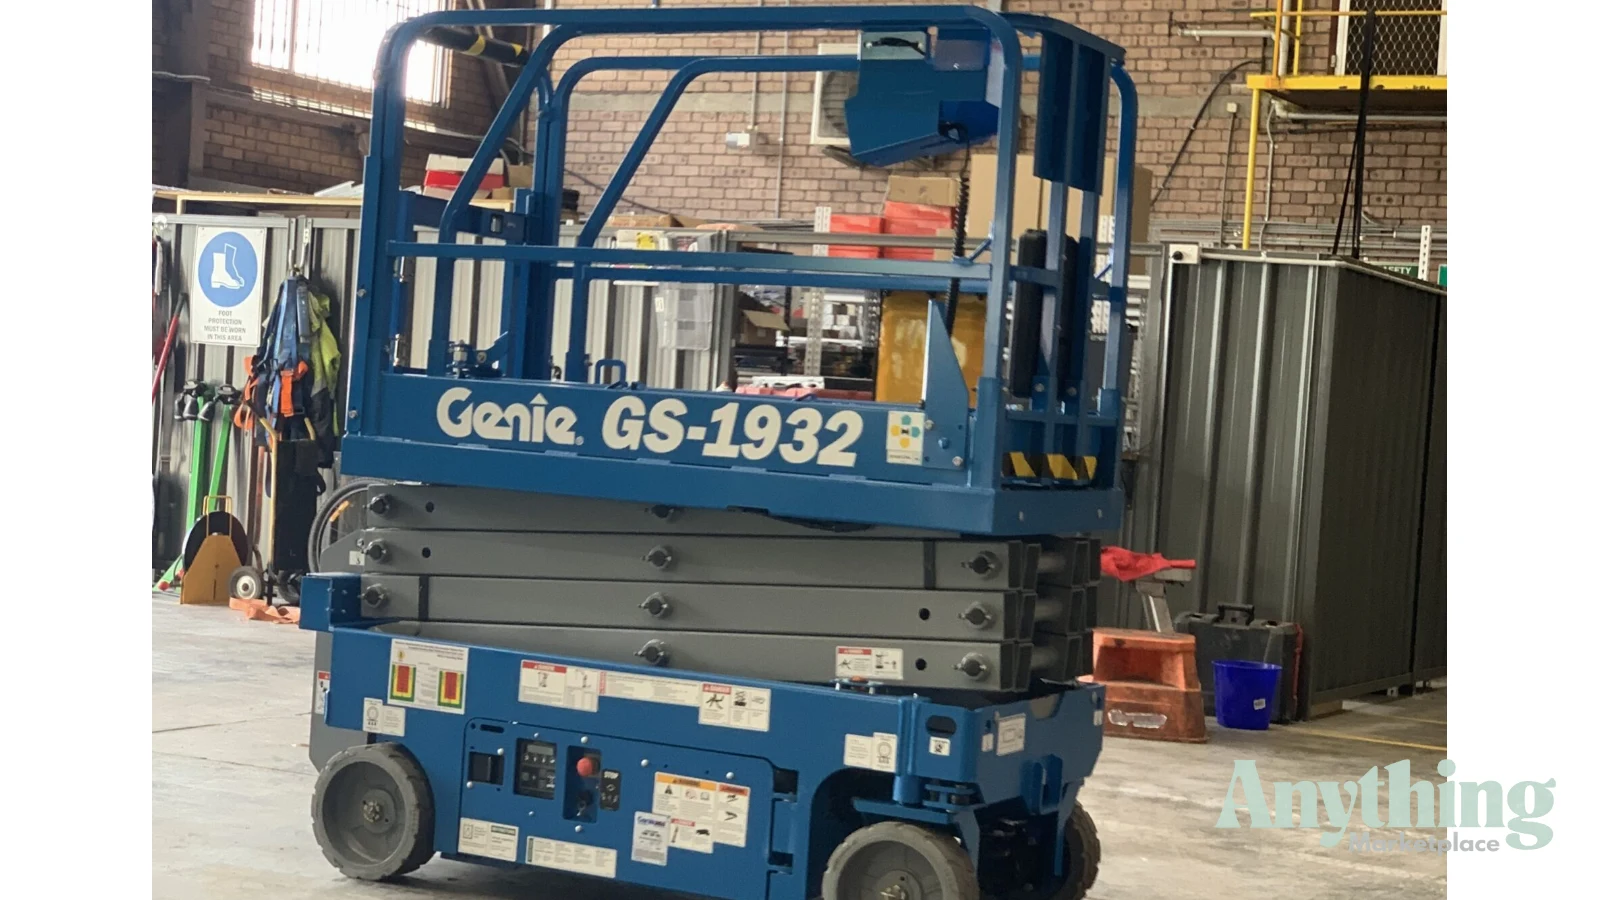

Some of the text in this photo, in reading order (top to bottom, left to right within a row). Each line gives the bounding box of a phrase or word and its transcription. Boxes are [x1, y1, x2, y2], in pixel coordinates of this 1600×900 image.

[436, 387, 864, 468] Genie GS-1932
[603, 770, 619, 779] STOP
